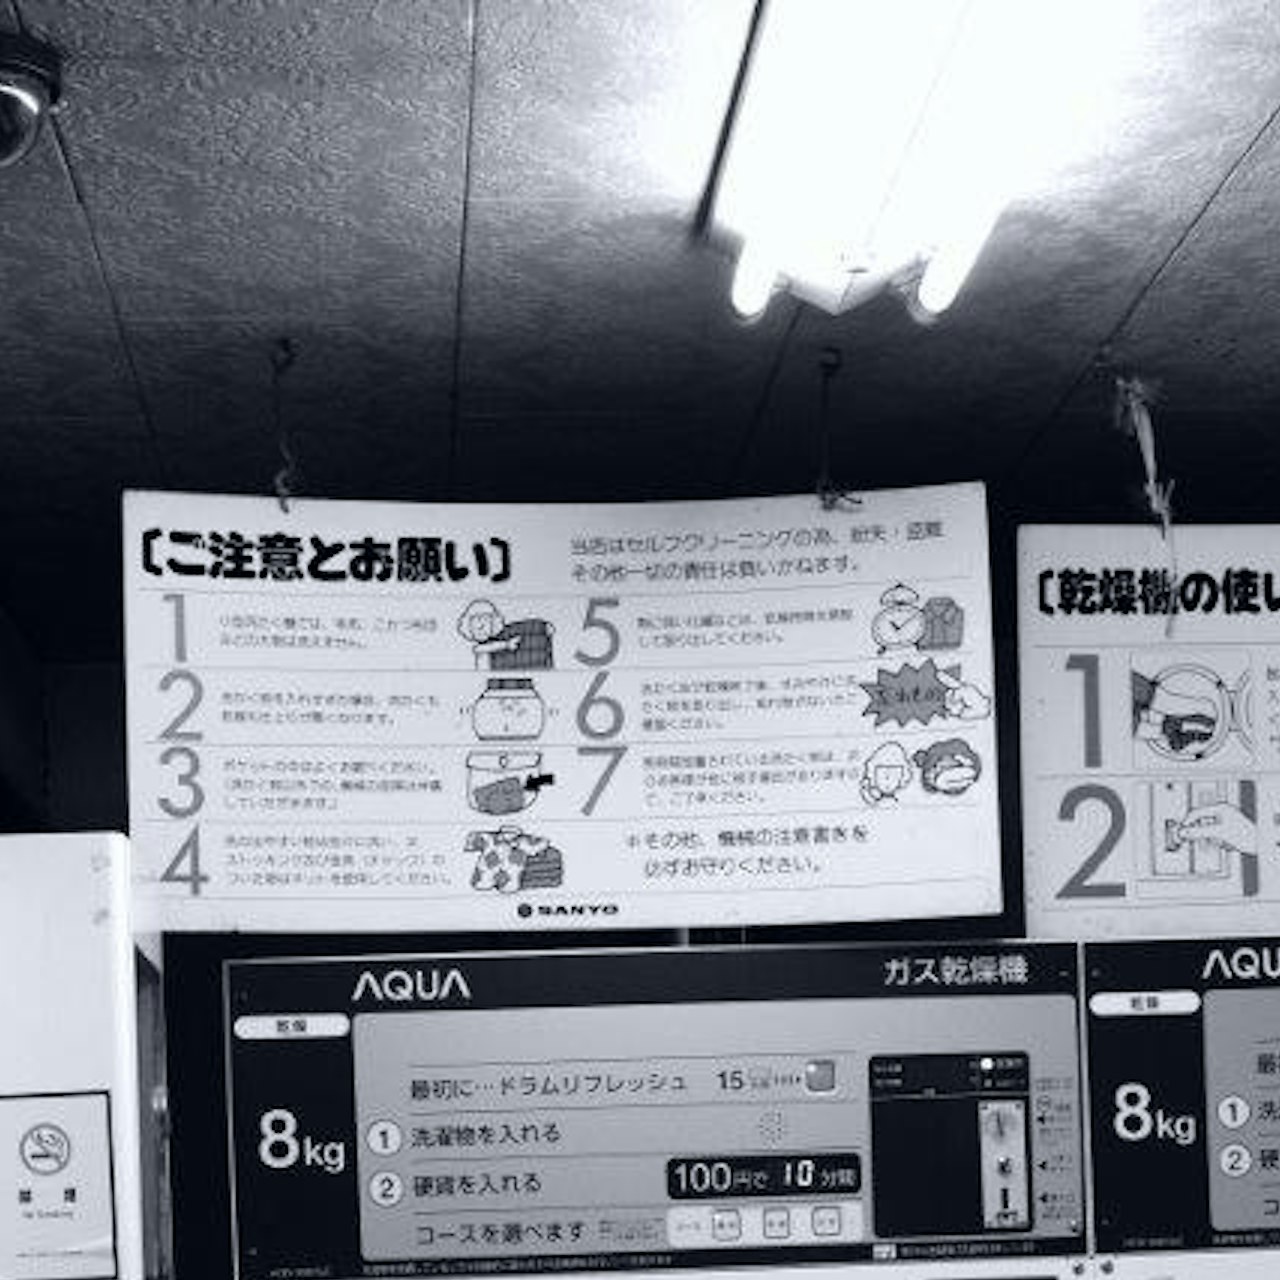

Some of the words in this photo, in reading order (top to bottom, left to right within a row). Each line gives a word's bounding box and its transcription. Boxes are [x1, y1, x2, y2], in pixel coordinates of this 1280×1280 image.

[162, 593, 188, 663] 1
[575, 597, 621, 668] 5
[159, 668, 204, 741] 2
[577, 670, 626, 739] 6
[1065, 653, 1103, 769] 1
[156, 746, 206, 820] 3
[577, 746, 629, 817] 7
[159, 824, 211, 897] 4
[1055, 782, 1127, 900] 2
[537, 903, 620, 918] SANYO
[351, 967, 473, 1002] AQUA
[884, 953, 1029, 987] ガス乾燥機
[716, 1069, 745, 1091] 15
[1113, 1081, 1197, 1146] 8kg
[258, 1107, 347, 1174] 8kg
[411, 1123, 563, 1150] 洗濯物を入れる
[413, 1172, 543, 1198] 硬貨を入れる
[414, 1222, 585, 1247] コースを選べます
